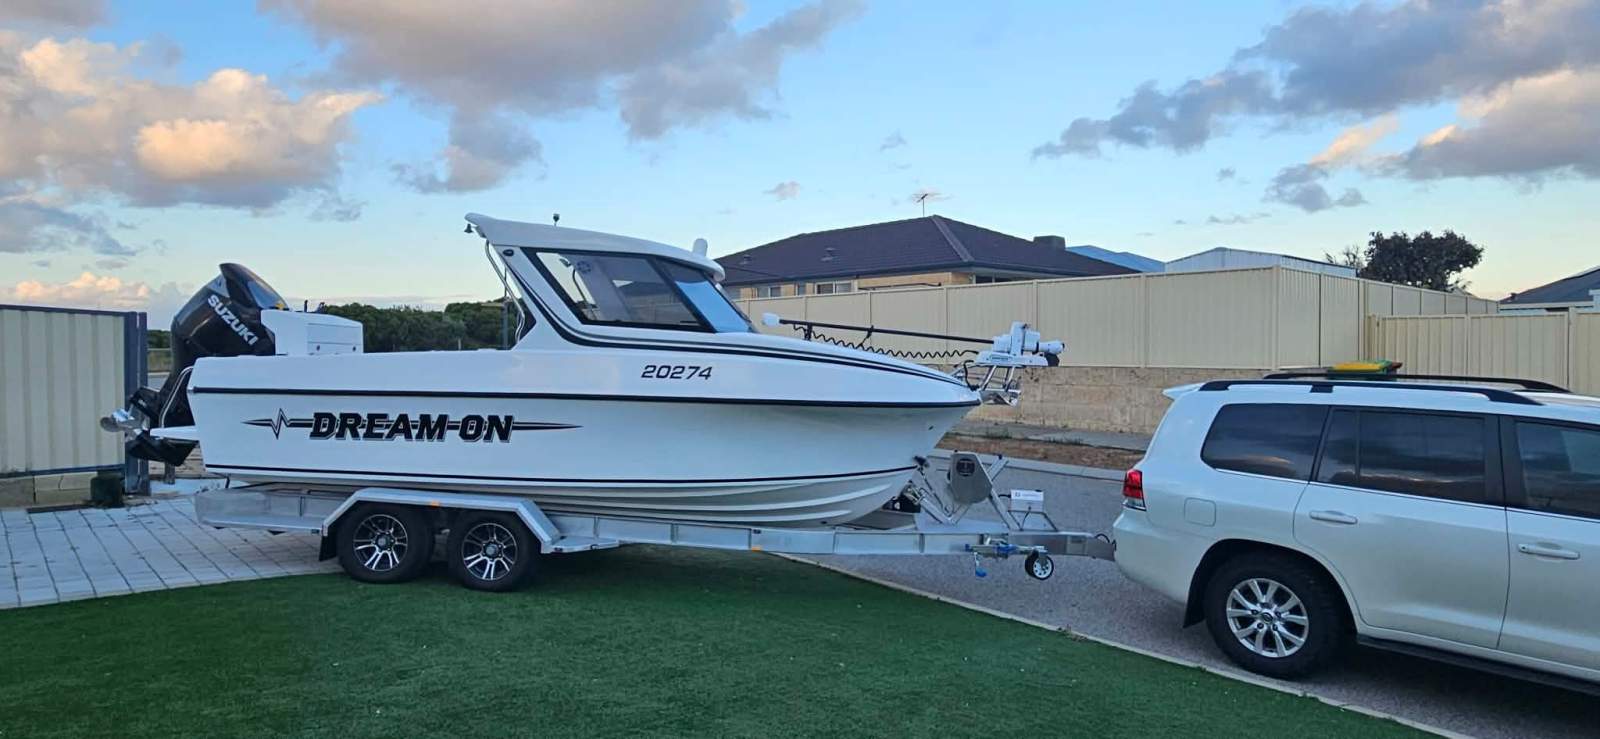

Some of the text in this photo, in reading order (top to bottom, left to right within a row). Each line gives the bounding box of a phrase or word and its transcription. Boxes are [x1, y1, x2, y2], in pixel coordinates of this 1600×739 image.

[207, 294, 259, 346] SUZUKI
[641, 365, 713, 381] 20274
[309, 412, 514, 443] DREAM ON
